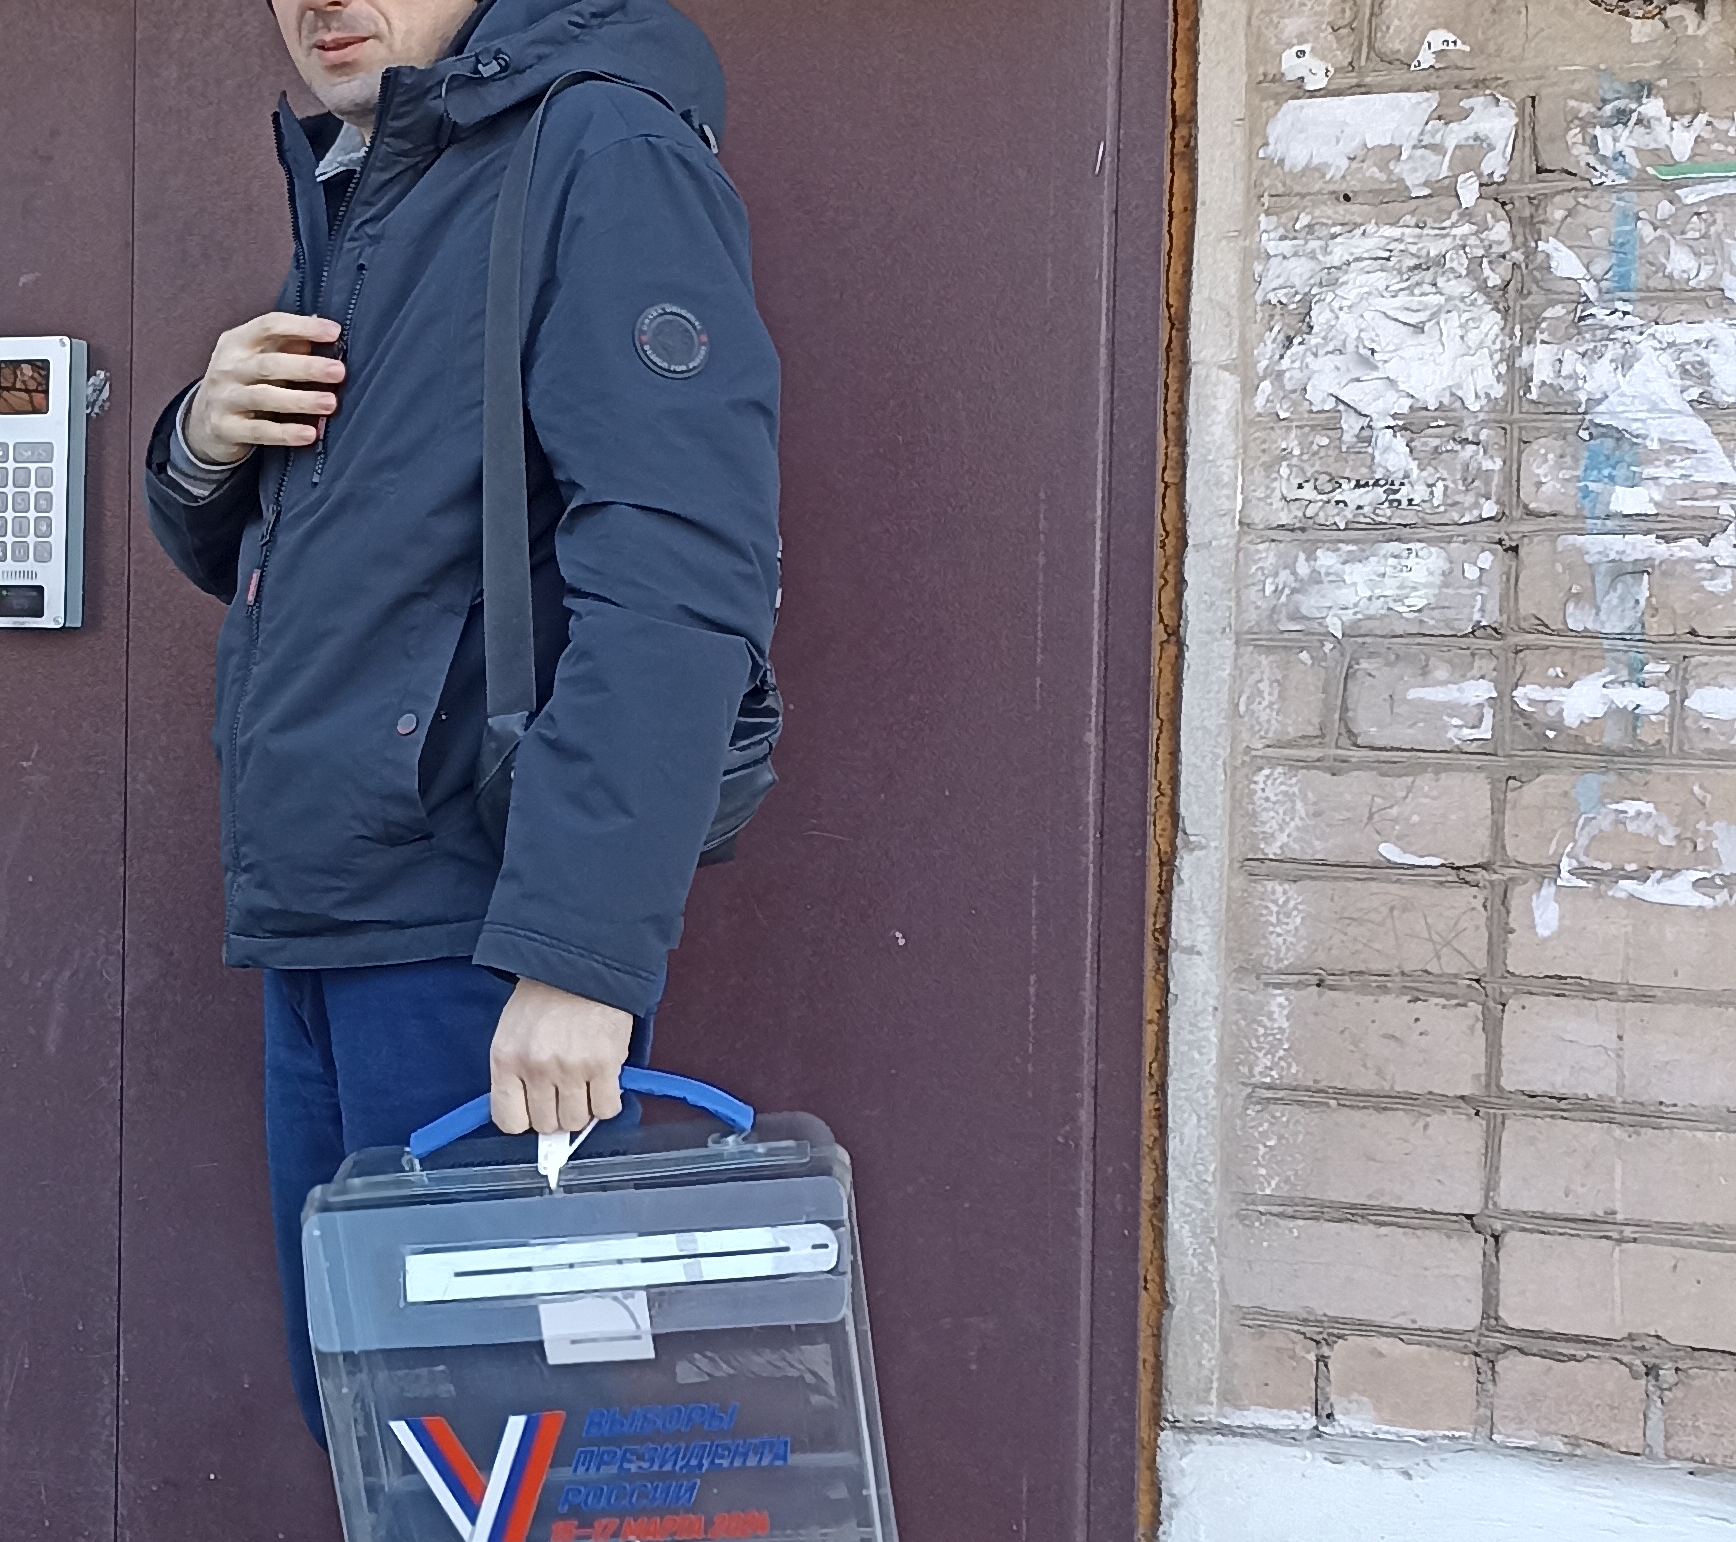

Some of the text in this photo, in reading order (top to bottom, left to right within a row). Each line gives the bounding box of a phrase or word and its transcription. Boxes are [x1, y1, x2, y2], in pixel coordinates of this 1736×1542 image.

[582, 1402, 740, 1438] ВЫБОРЫ
[570, 1435, 791, 1474] ПРЕЗИДЕНТА
[558, 1478, 701, 1514] РОССИИ
